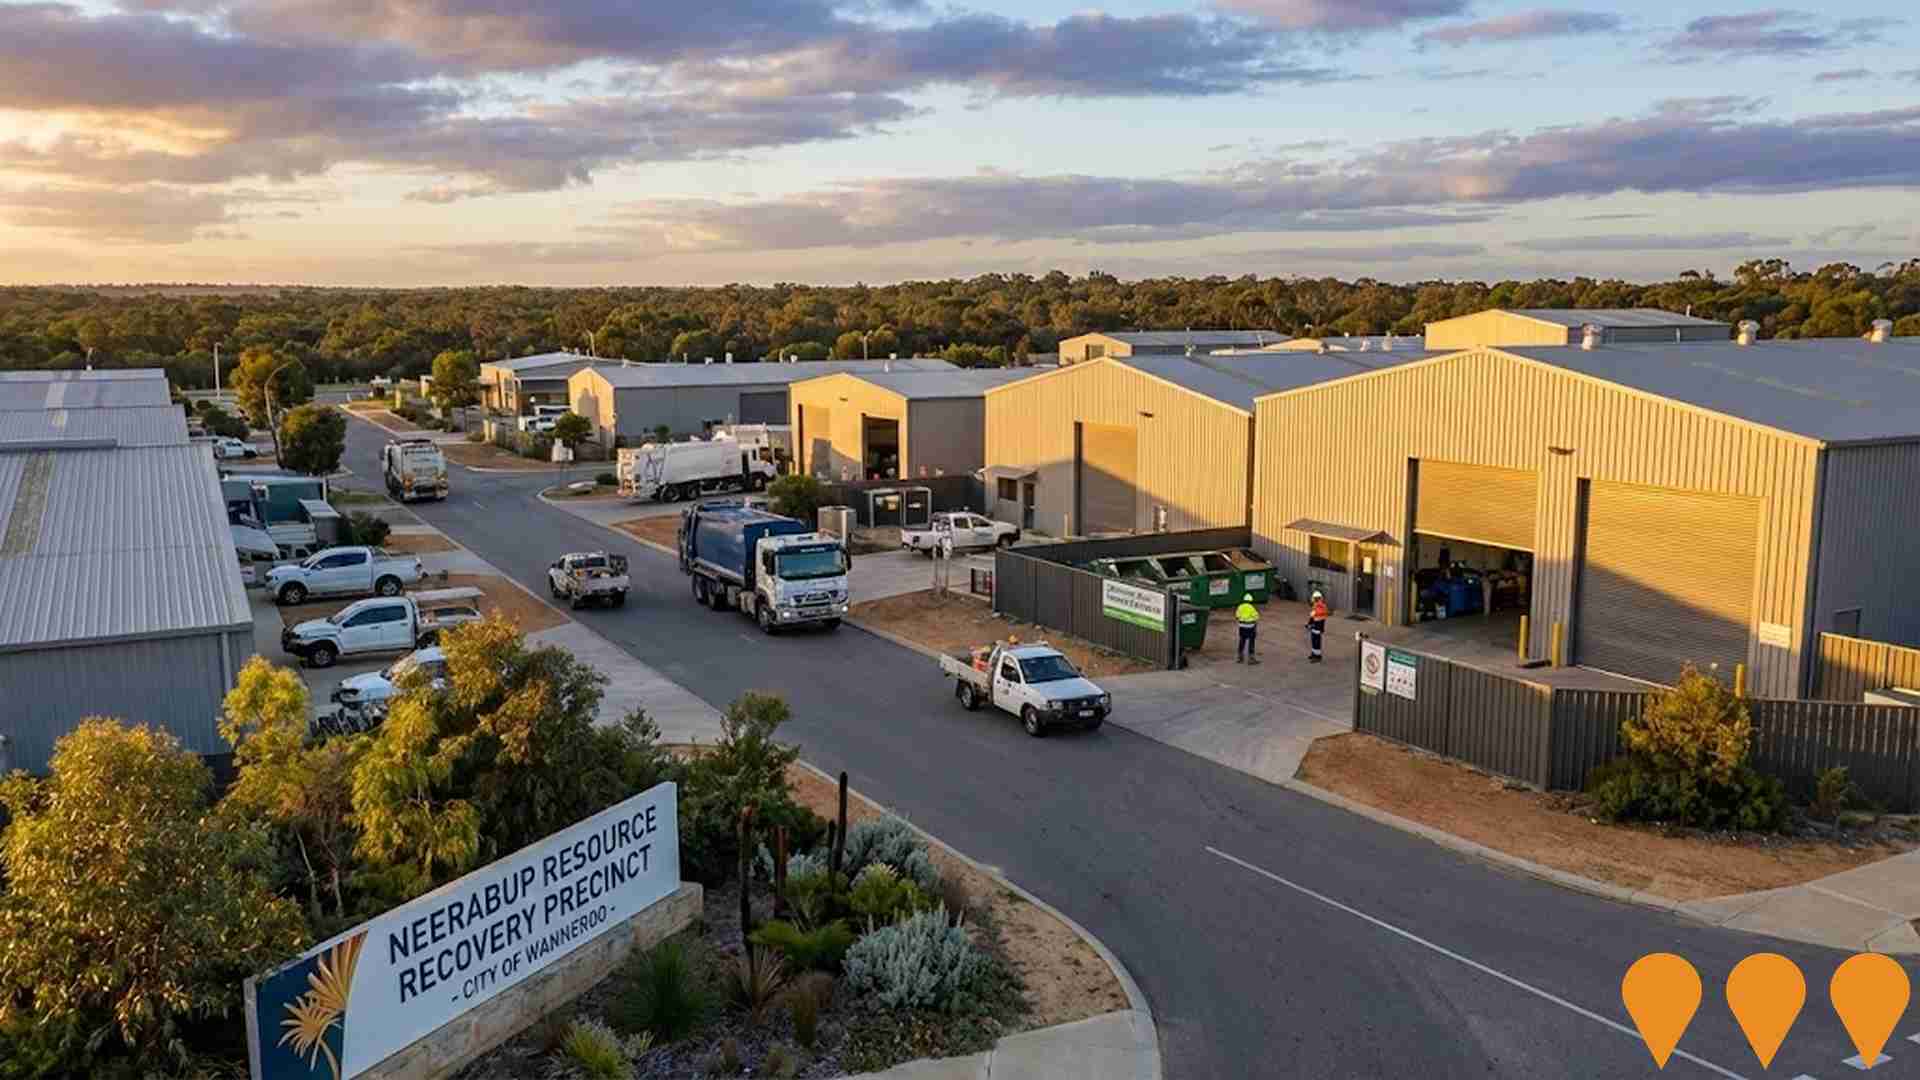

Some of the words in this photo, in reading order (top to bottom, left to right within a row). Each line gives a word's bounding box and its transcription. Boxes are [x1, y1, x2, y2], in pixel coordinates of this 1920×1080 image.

[389, 866, 535, 965] NEERABUP
[543, 806, 657, 887] RESOURCE
[400, 903, 536, 1003] RECOVERY
[543, 844, 652, 924] PRECINCT
[463, 965, 498, 999] CITY
[502, 952, 522, 977] OF
[526, 905, 607, 963] WANNEROO
